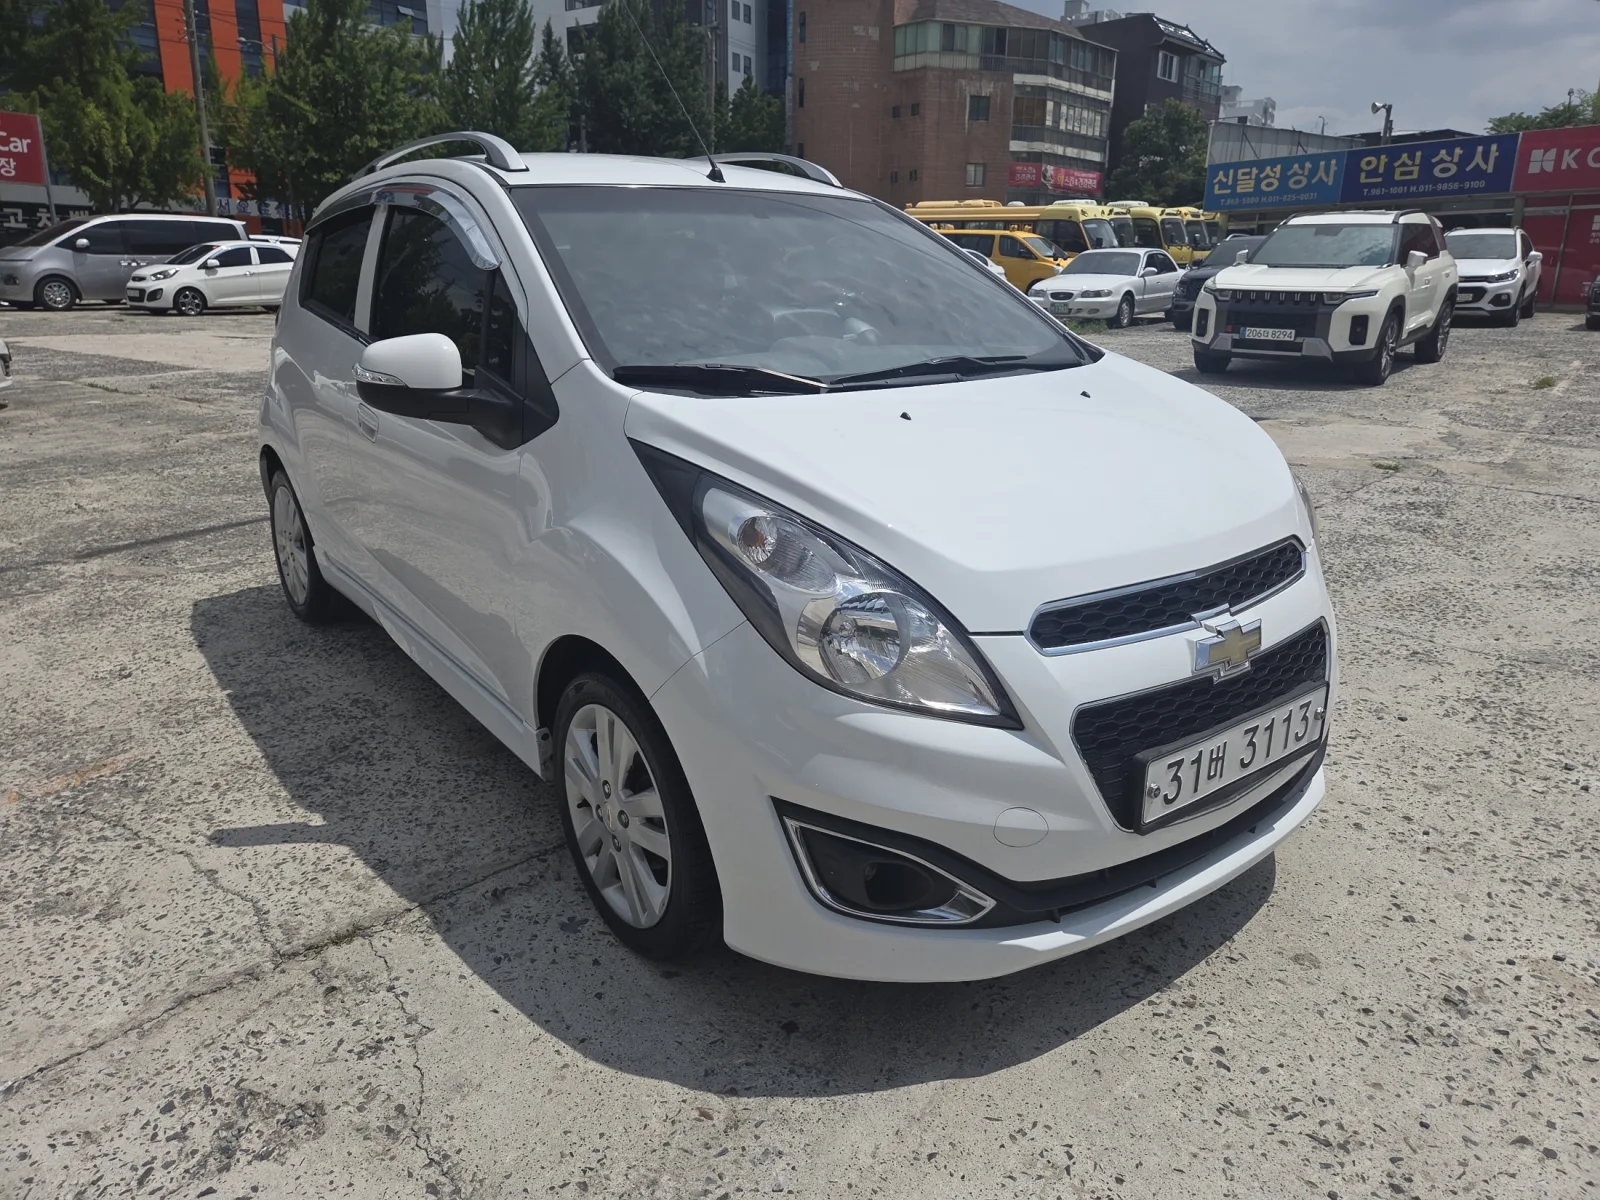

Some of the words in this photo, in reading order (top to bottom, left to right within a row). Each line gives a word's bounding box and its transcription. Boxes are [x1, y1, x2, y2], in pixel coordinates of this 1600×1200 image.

[1213, 164, 1281, 194] 신달성
[1287, 159, 1337, 189] 상사
[1360, 151, 1422, 183] 안심
[1431, 143, 1499, 178] 상사
[1271, 330, 1293, 339] 8294
[1163, 740, 1228, 805] 31버
[1240, 700, 1312, 769] 3113
